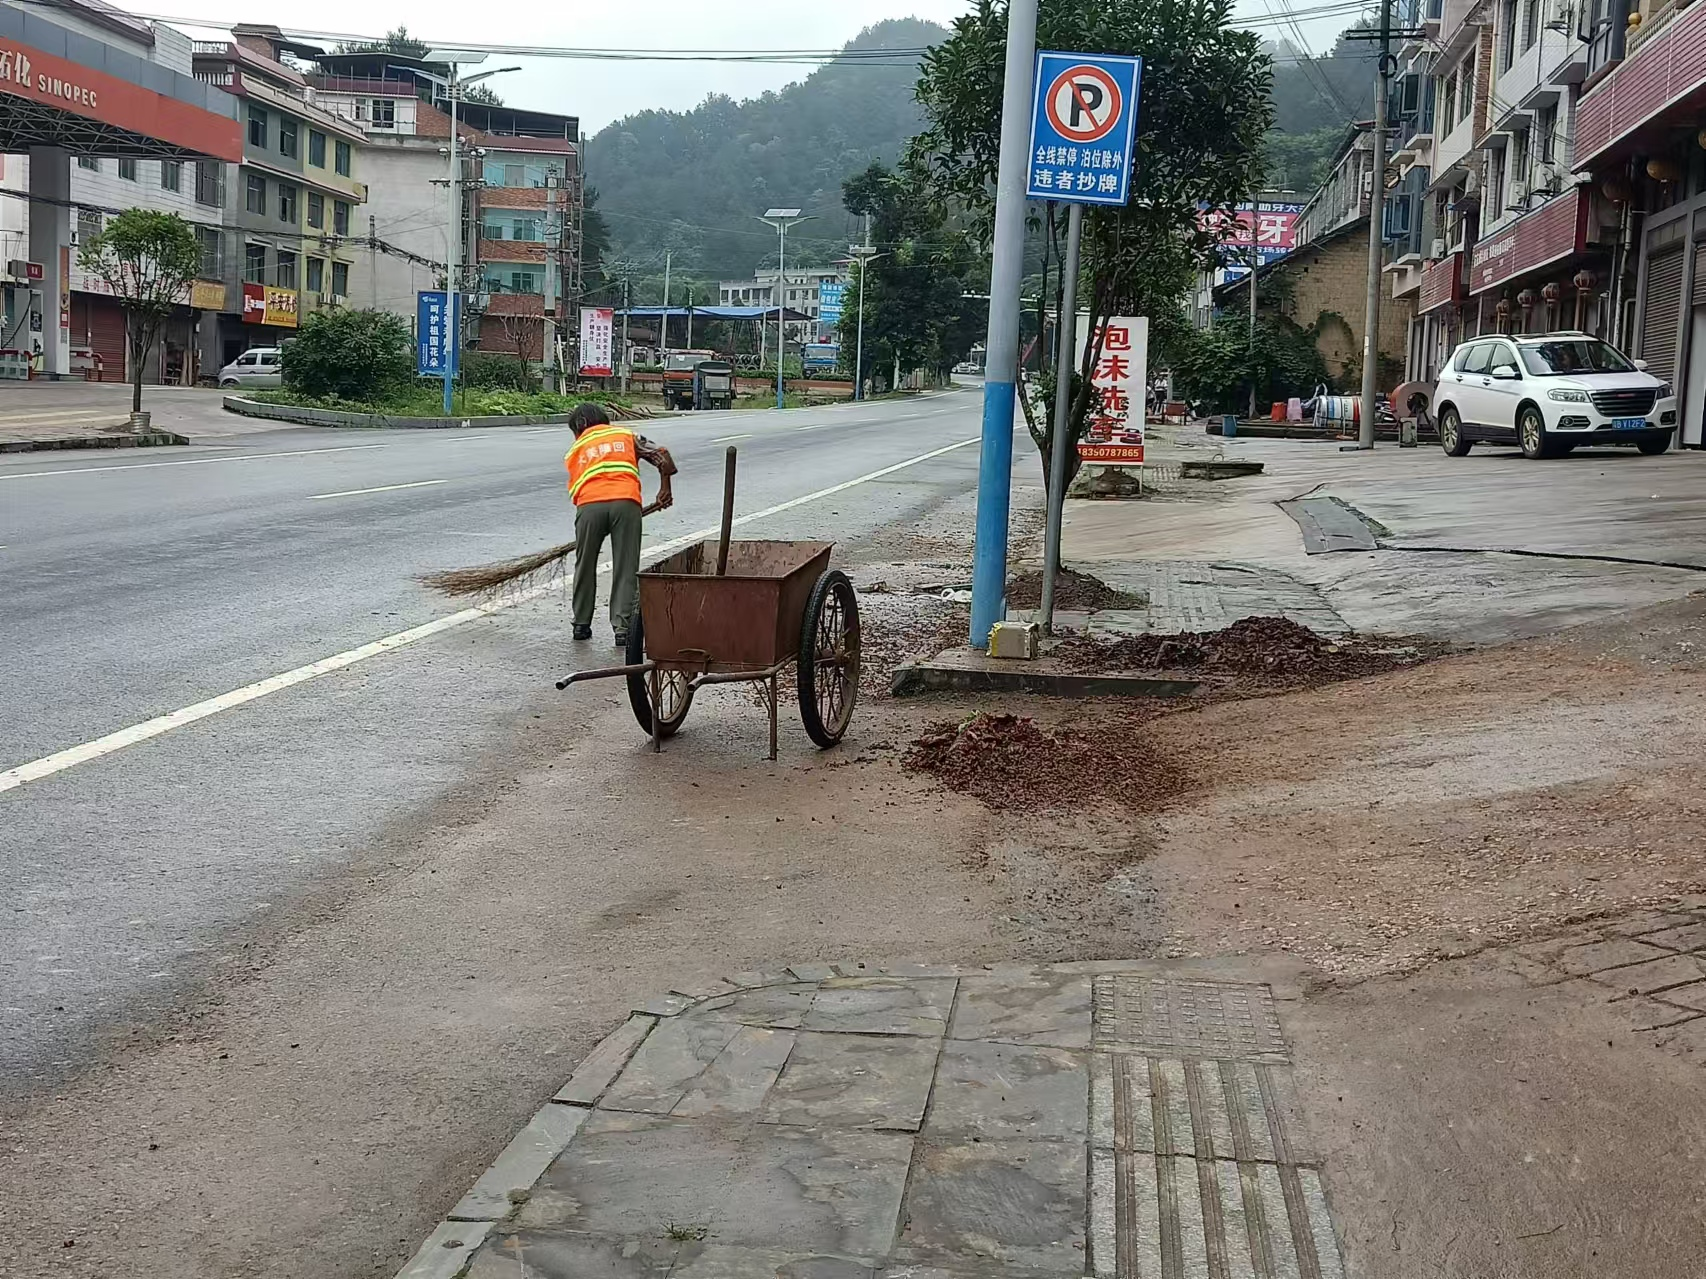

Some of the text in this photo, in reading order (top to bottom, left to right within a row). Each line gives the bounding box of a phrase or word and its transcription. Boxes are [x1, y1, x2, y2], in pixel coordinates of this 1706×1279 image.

[0, 50, 31, 87] 石化
[39, 74, 97, 108] SINOPEC
[1036, 145, 1122, 170] 全线禁停 泊位除外
[1034, 169, 1118, 193] 违者抄牌
[429, 305, 439, 368] 呵护祖国花朵
[1089, 325, 1131, 441] 泡沫洗车
